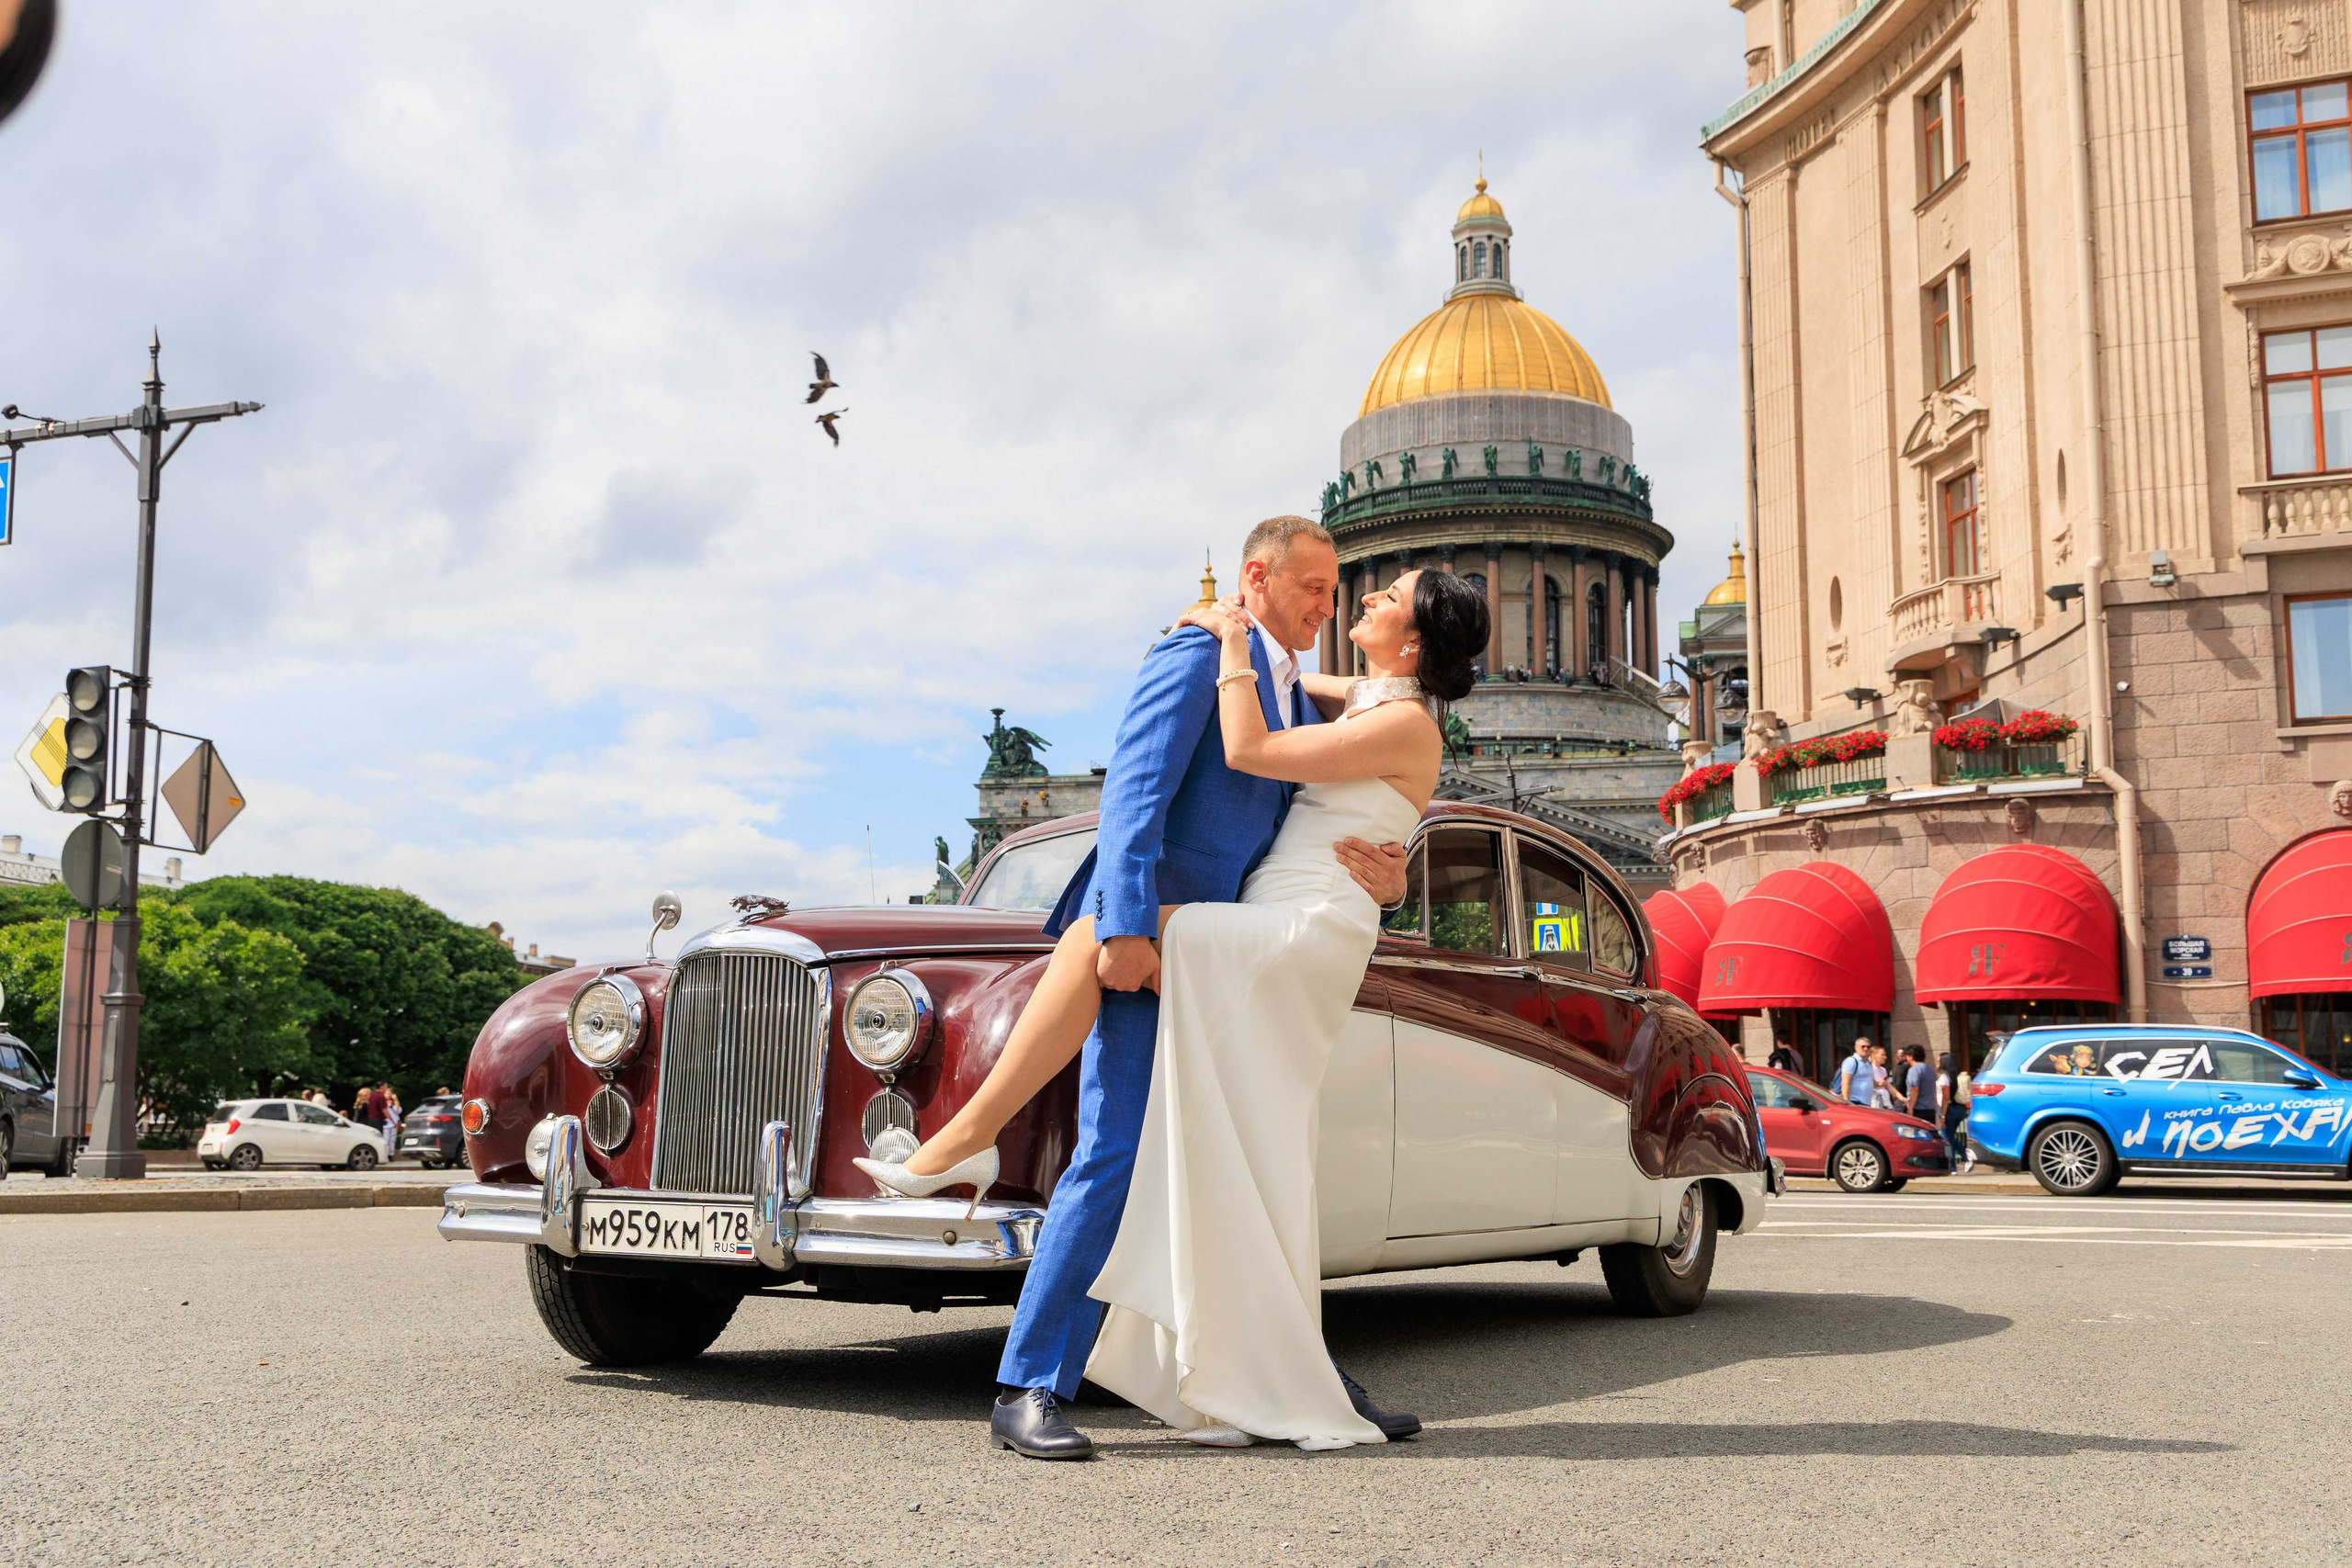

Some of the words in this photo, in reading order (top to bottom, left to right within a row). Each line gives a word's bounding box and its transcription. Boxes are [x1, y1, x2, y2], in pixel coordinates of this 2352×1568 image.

[2104, 1043, 2214, 1090] СЕЛ
[2218, 1101, 2276, 1115] Павла
[707, 1211, 748, 1241] 178
[714, 1242, 736, 1253] RUS
